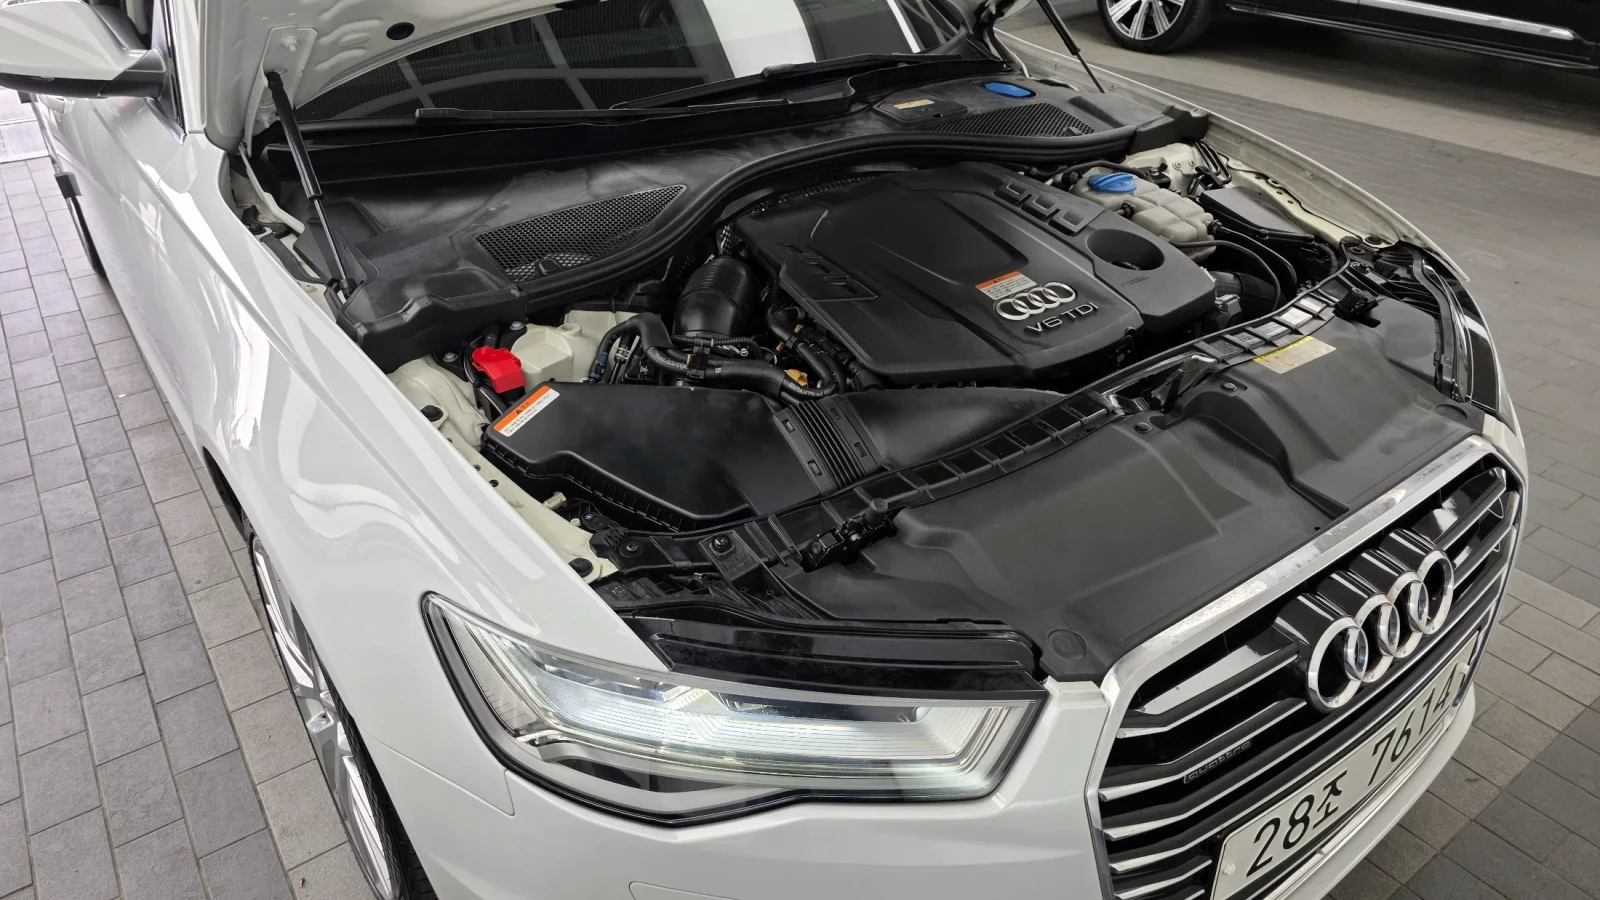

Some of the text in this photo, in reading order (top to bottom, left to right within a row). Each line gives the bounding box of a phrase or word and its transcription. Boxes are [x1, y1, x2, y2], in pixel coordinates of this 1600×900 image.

[1026, 302, 1099, 333] V6 TDI
[1185, 740, 1251, 783] quattro
[1246, 662, 1459, 878] 28조 7614
